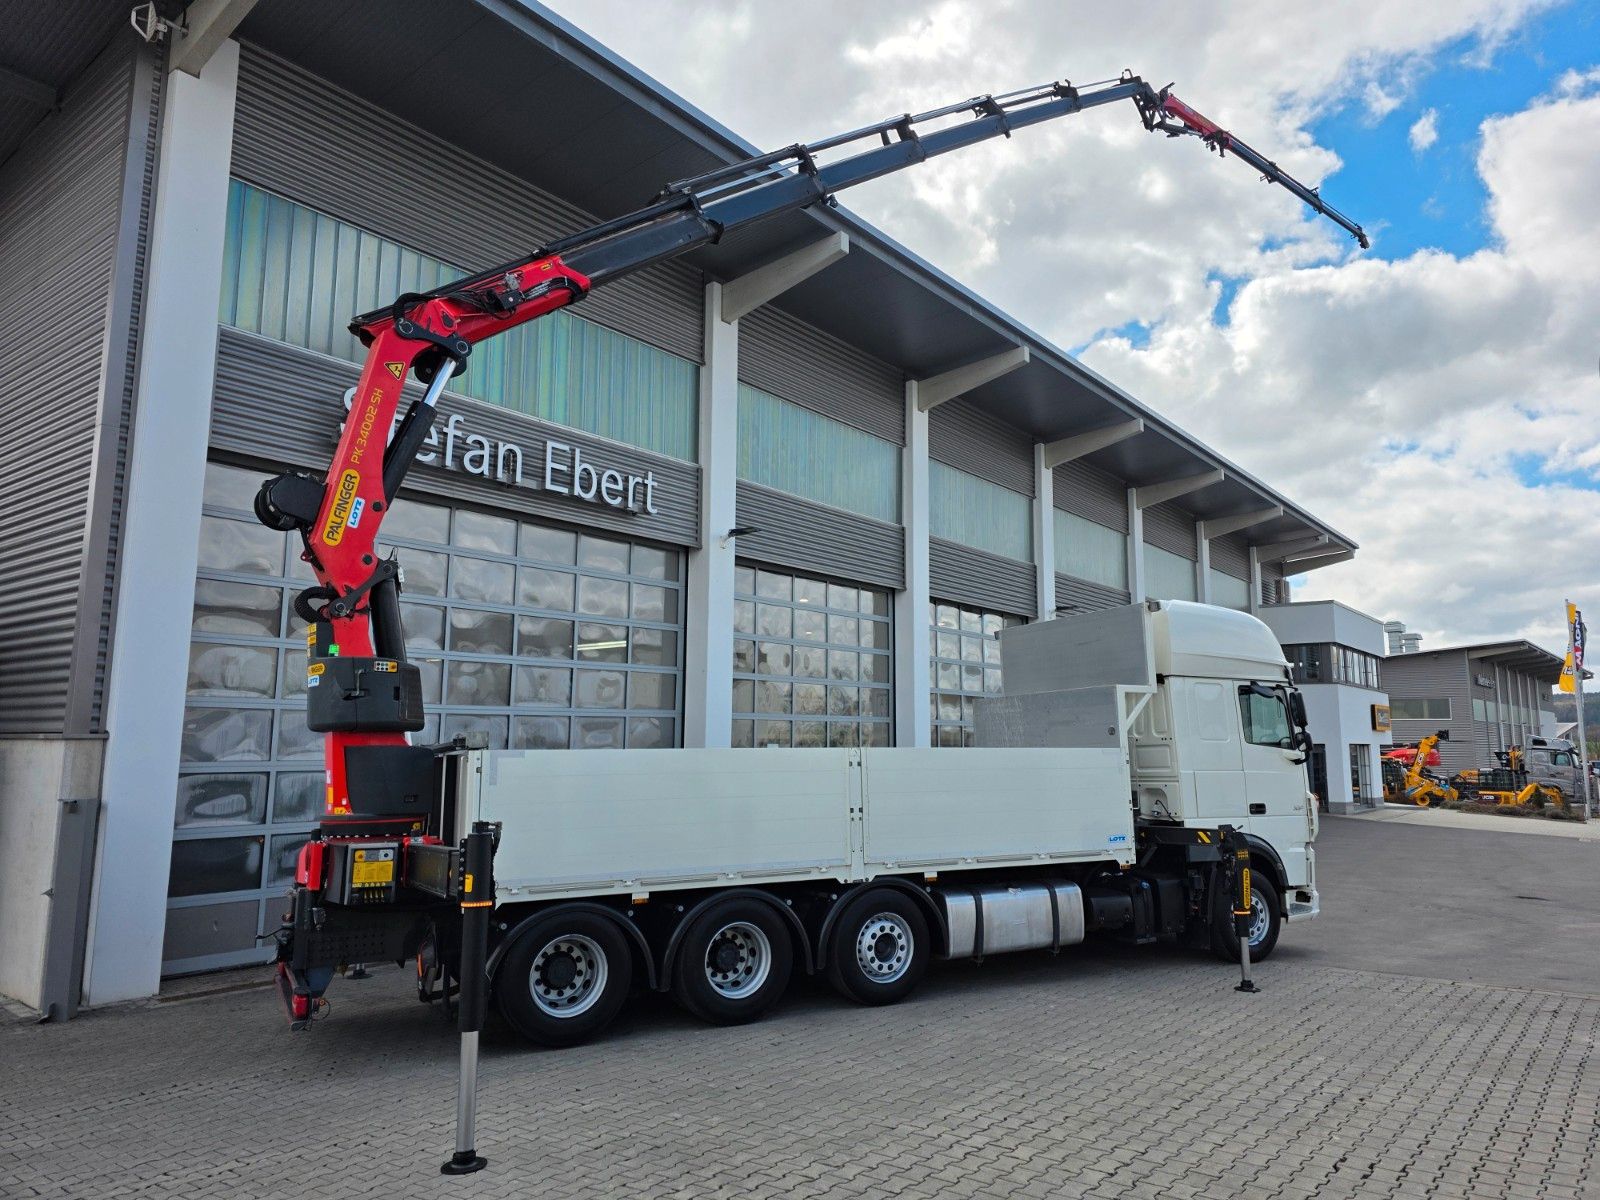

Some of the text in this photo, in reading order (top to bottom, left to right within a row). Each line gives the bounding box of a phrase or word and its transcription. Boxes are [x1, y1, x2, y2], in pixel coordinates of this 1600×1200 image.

[351, 387, 384, 465] PK 34002 SH
[326, 473, 358, 542] PALFINGER
[350, 498, 363, 527] LOTZ
[545, 440, 658, 514] Ebert
